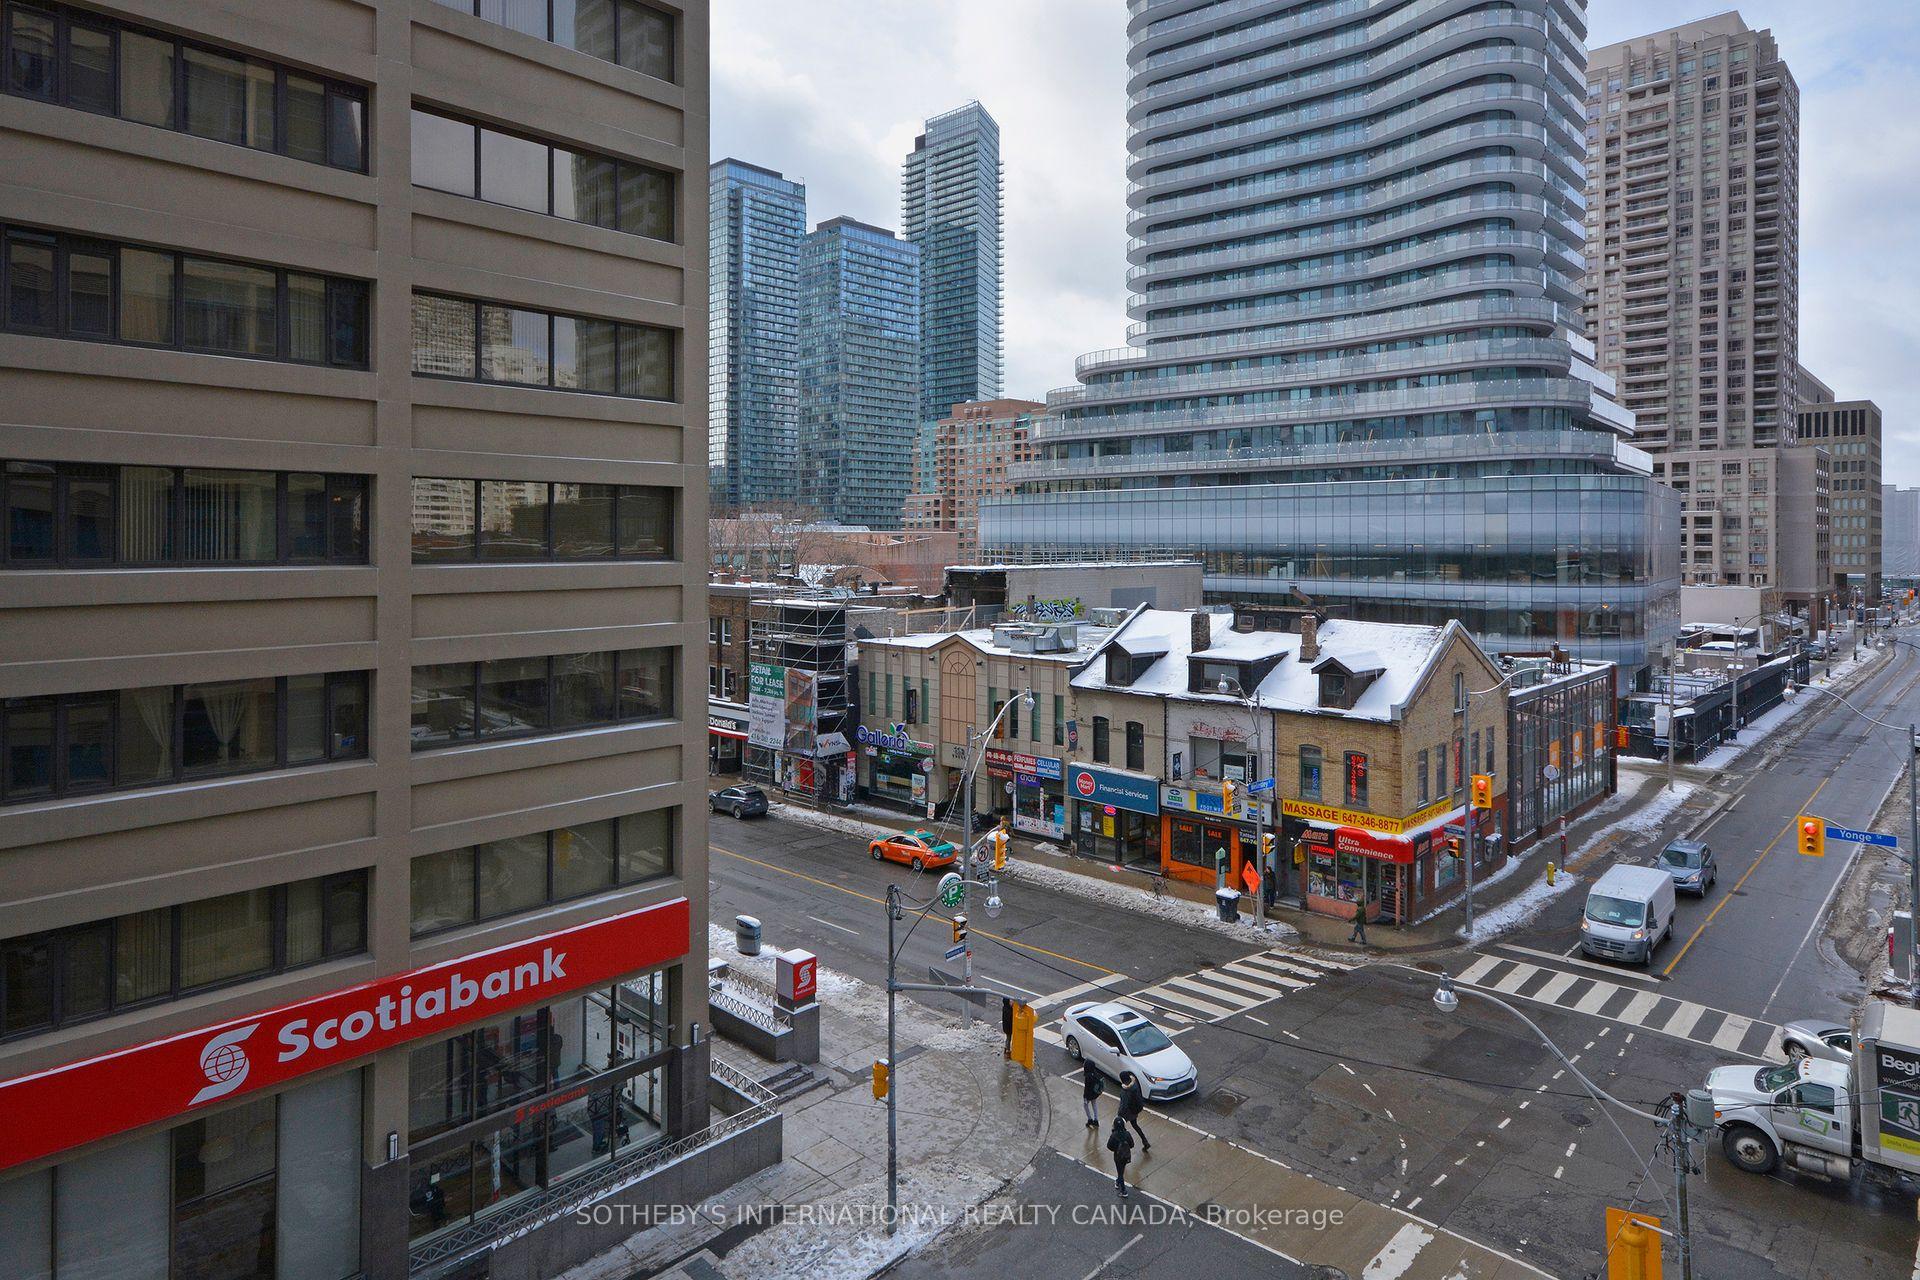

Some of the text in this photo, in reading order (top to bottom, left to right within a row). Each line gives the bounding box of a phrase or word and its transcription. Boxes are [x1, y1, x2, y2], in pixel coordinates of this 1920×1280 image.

[751, 664, 772, 676] RETAIL
[751, 675, 784, 688] FOR LEASE
[856, 725, 906, 751] Galleria
[1079, 778, 1092, 786] Money
[1099, 784, 1149, 800] Financial Services
[1284, 802, 1400, 832] MASSAGE 647-346-8877
[1338, 835, 1360, 846] Ultra
[1840, 829, 1872, 842] Yonge
[1337, 842, 1394, 860] Convenience
[949, 885, 958, 898] P
[277, 948, 567, 1063] Scotiabank
